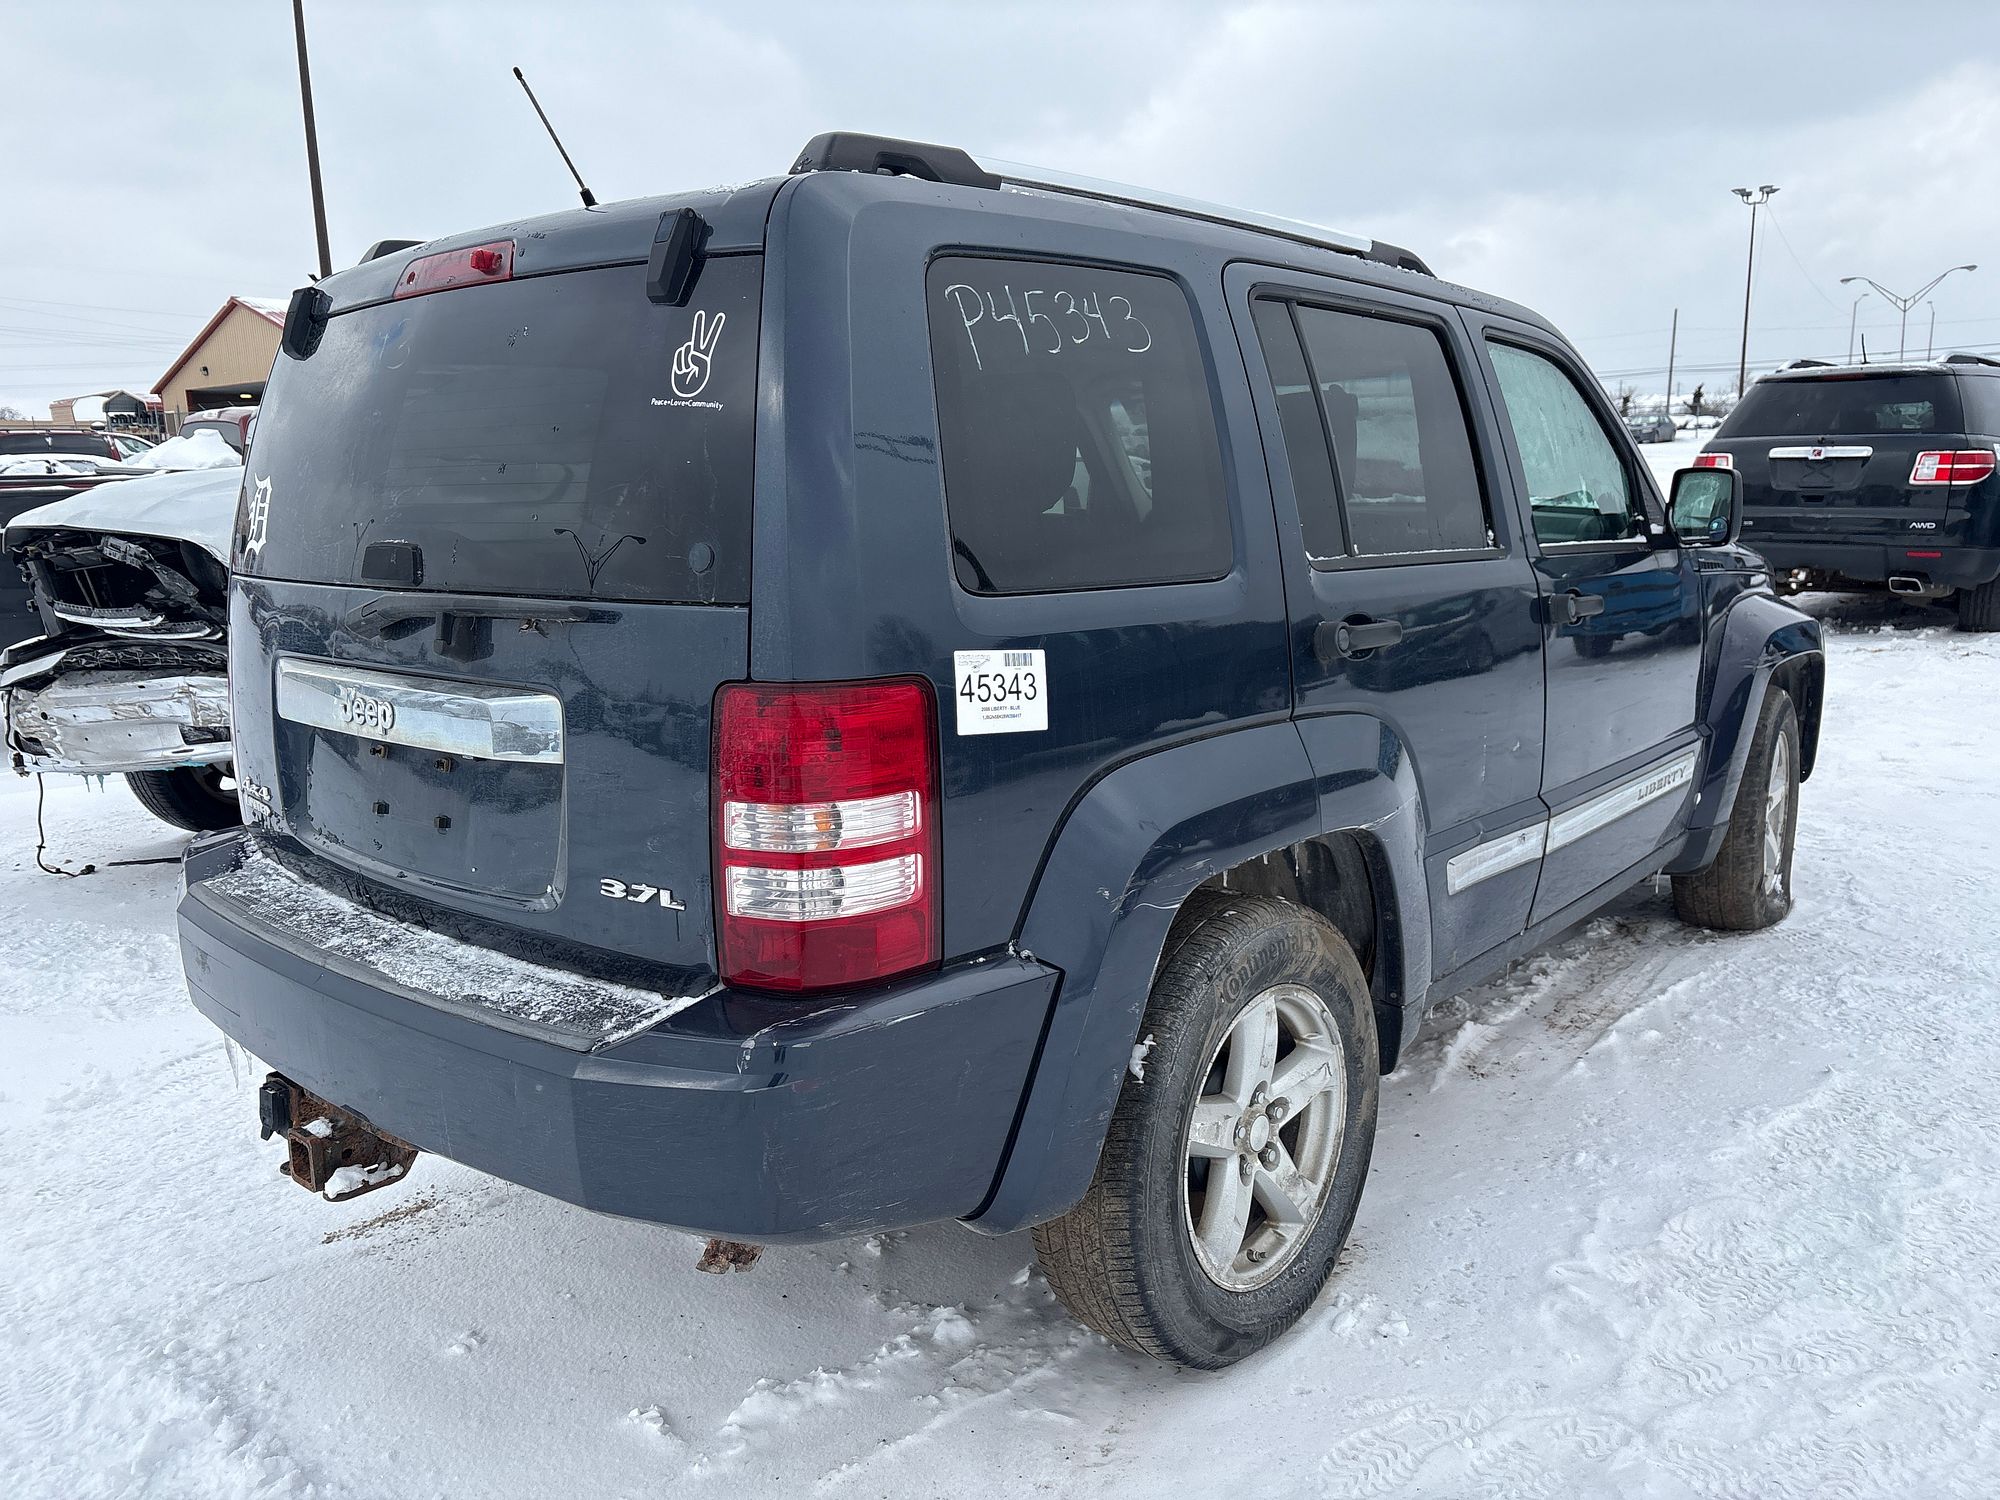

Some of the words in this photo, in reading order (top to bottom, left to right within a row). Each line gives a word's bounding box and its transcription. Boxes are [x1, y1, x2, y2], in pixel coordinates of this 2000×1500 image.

[944, 284, 1152, 371] P45343
[1908, 521, 1937, 530] AWD
[959, 672, 1037, 703] 45343
[339, 687, 395, 735] Jeep
[1637, 764, 1687, 801] LIBERTY
[600, 878, 686, 911] 3.7L
